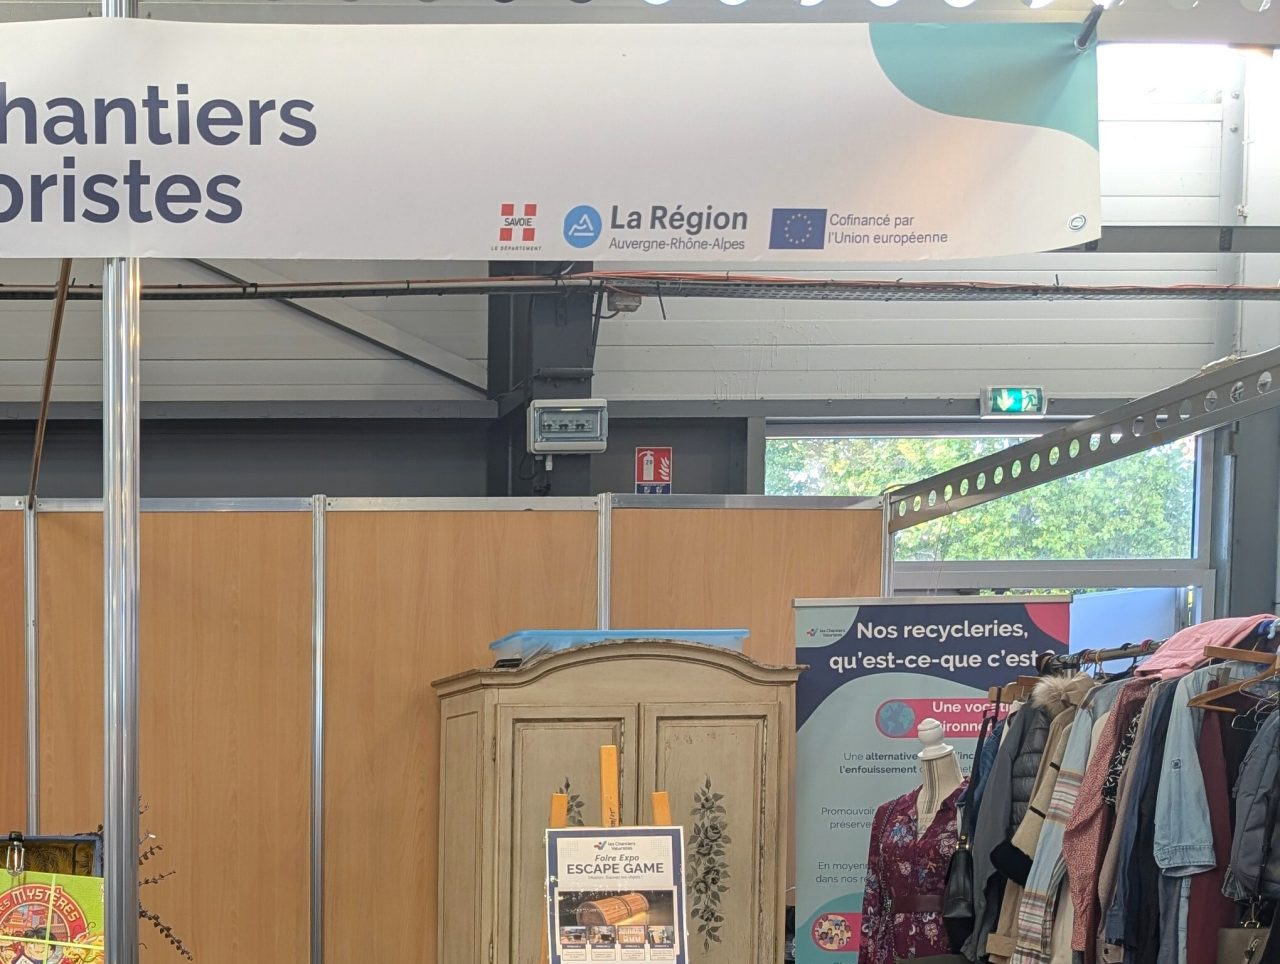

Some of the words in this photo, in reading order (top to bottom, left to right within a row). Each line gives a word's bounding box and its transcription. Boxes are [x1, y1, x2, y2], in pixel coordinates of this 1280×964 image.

[504, 217, 533, 227] SAVOIE
[610, 205, 642, 230] La
[650, 204, 748, 236] Région
[829, 213, 891, 227] Cofinancé
[894, 215, 915, 229] par
[608, 237, 746, 252] Auvergne-Rhône-Alpes
[827, 231, 870, 244] l'Union
[873, 231, 949, 246] européenne
[857, 621, 898, 639] Nos
[904, 619, 1028, 642] recycleries,
[829, 651, 982, 673] qu'est-ce-que
[987, 649, 1039, 667] c'est
[933, 701, 961, 713] Une
[843, 752, 864, 761] Une
[865, 751, 918, 761] alternative
[839, 764, 917, 774] l'enfouissement
[821, 806, 875, 816] Promouvoir
[829, 820, 872, 830] préserve
[594, 854, 617, 862] Foire
[619, 853, 640, 863] Expo
[566, 863, 621, 875] ESCAPE
[623, 862, 664, 874] GAME
[818, 861, 830, 870] En
[832, 862, 868, 872] moyen
[815, 874, 839, 883] dans
[840, 875, 858, 883] nos
[11, 888, 81, 923] MYSTÈRES
